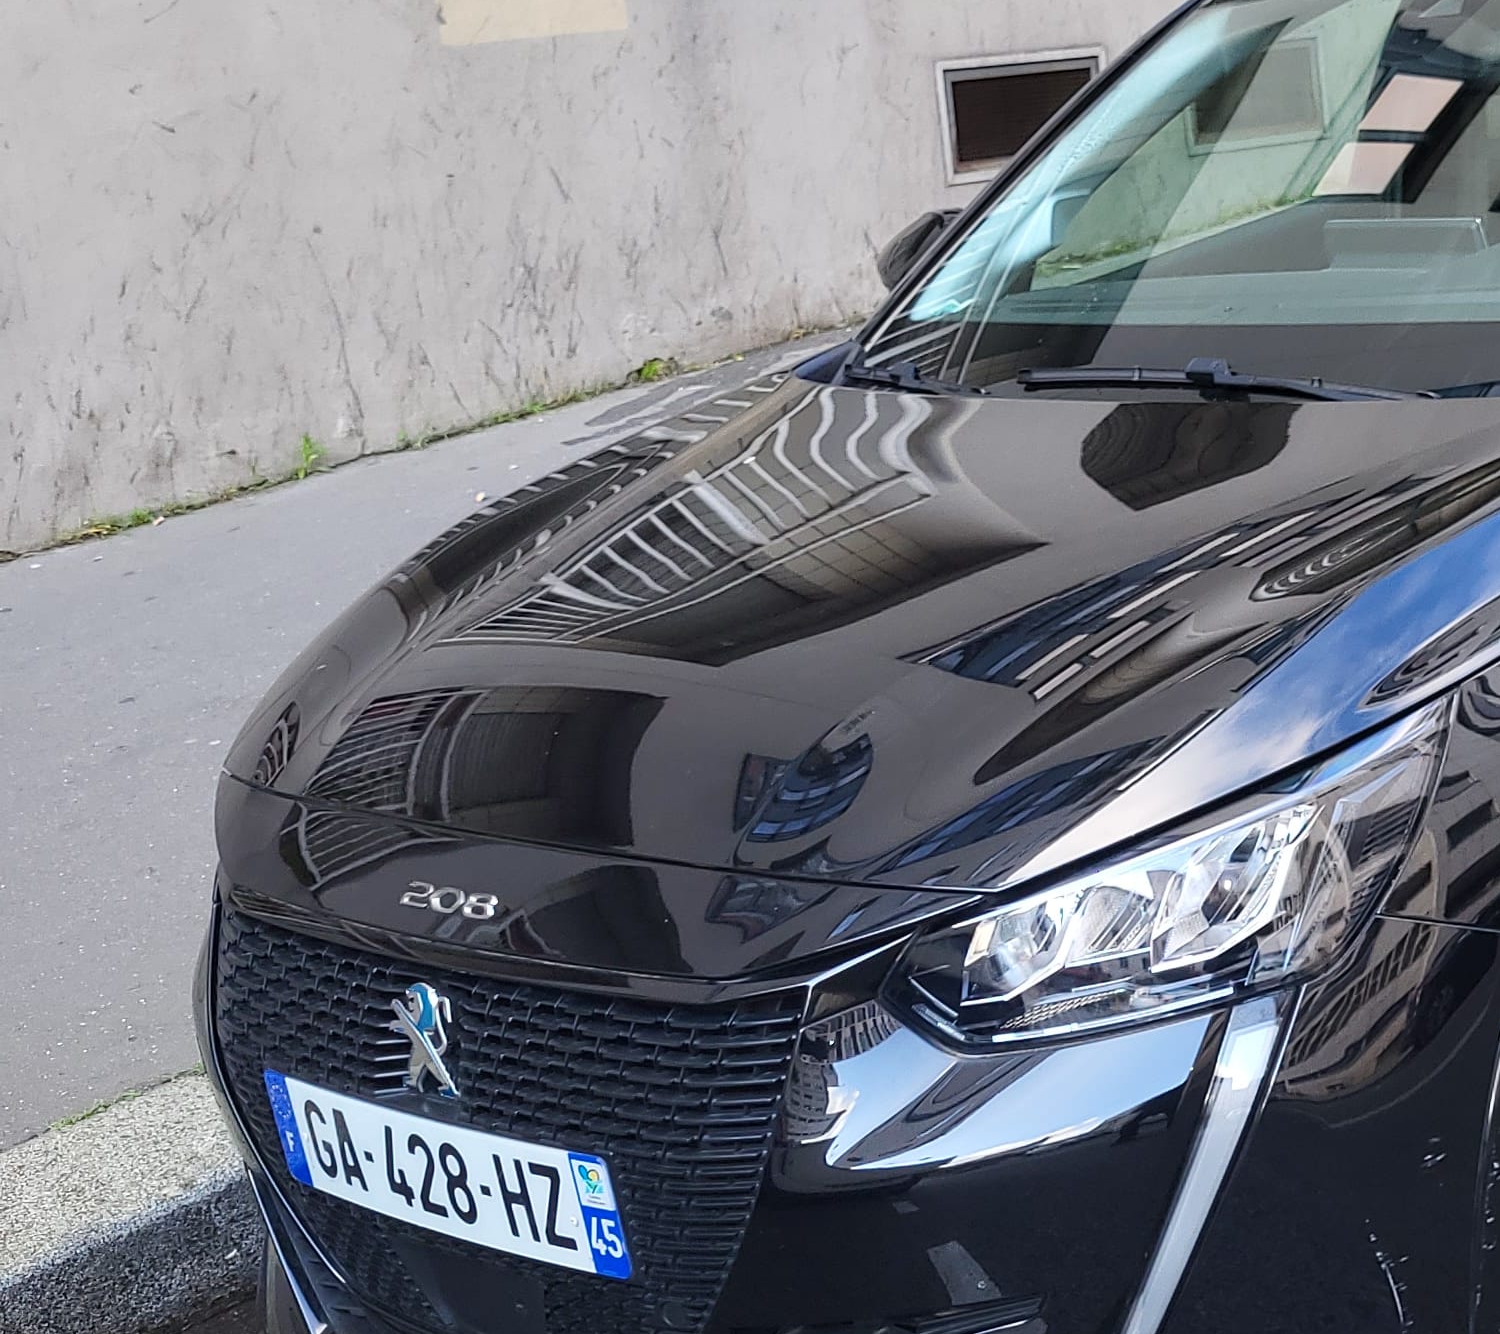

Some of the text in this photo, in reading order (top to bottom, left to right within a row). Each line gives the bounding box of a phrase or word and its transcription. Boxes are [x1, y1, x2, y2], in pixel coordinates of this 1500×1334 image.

[400, 881, 499, 919] 208
[285, 1130, 295, 1152] F
[304, 1099, 579, 1252] GA-428-HZ
[591, 1216, 623, 1258] 45
